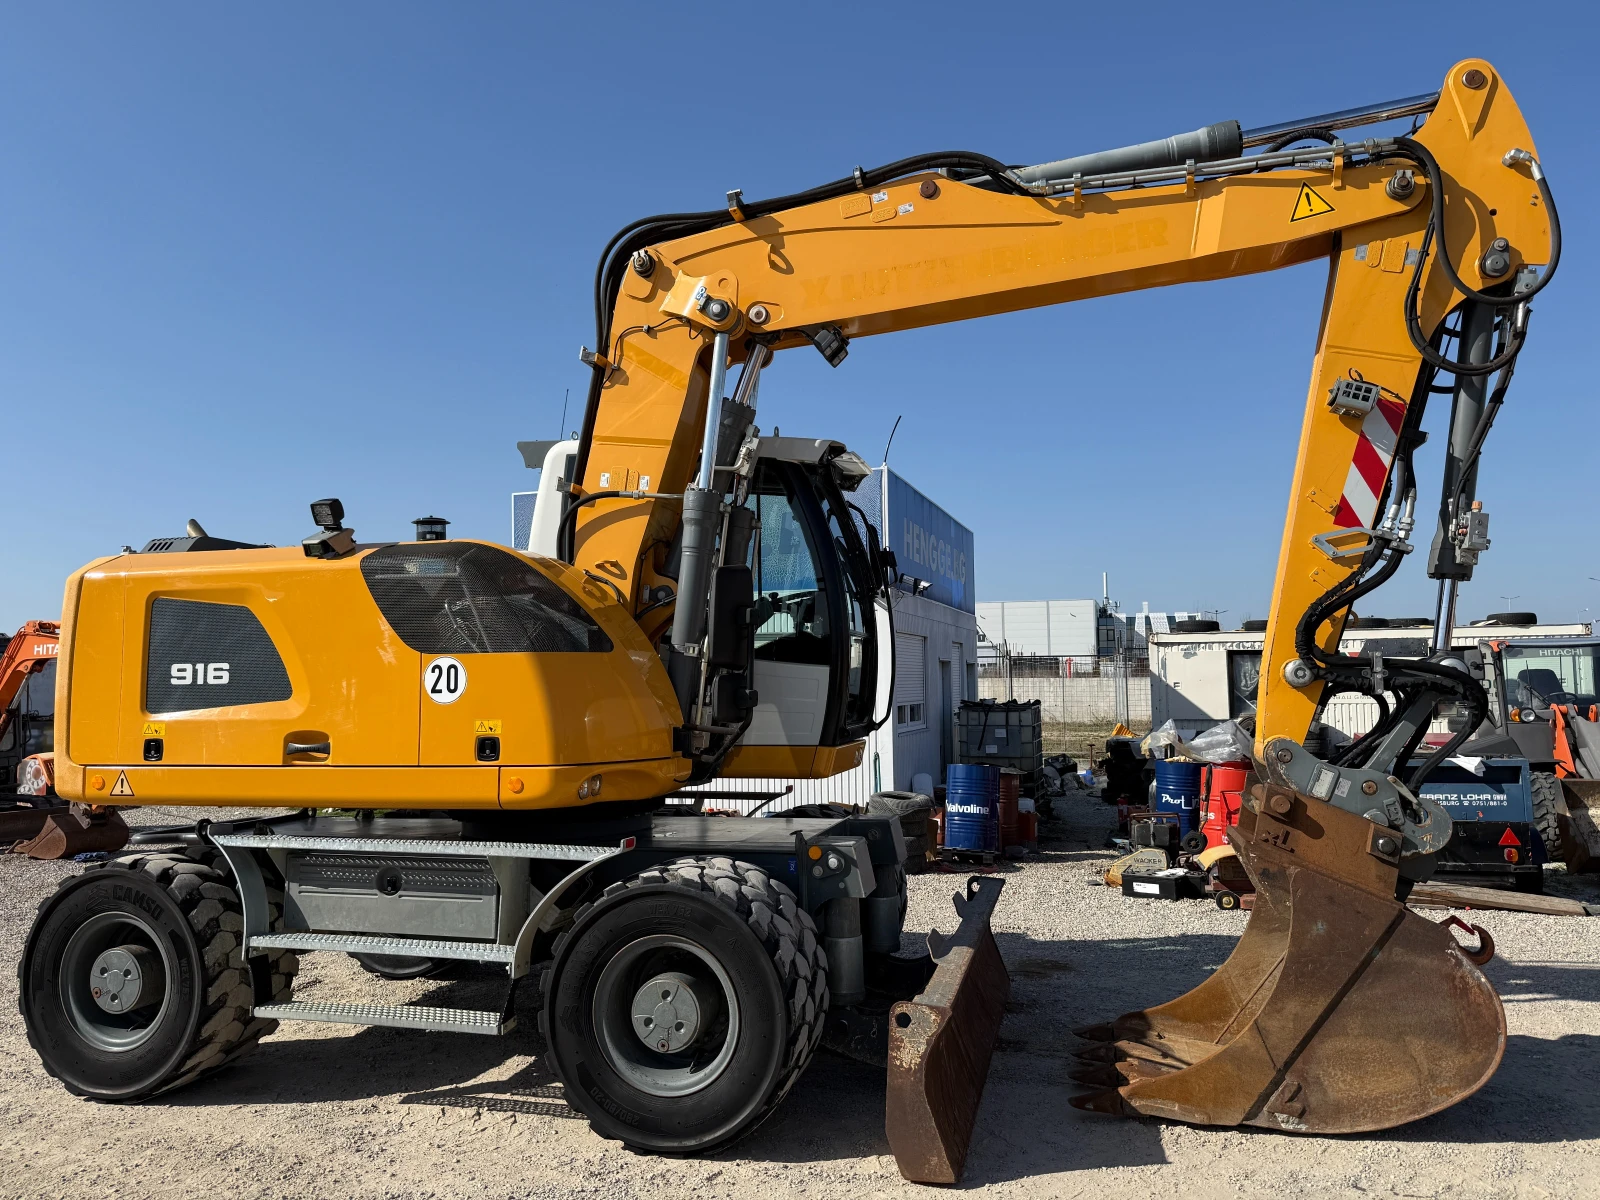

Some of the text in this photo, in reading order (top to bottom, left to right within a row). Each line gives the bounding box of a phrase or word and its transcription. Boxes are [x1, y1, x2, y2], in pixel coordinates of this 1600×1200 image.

[1539, 648, 1583, 656] HITACHI
[170, 662, 230, 685] 916
[430, 663, 459, 694] 20
[1420, 793, 1458, 801] FRANZ
[1460, 793, 1491, 801] LOHR
[946, 800, 990, 815] Valvoline
[1133, 857, 1163, 865] WACKER
[112, 884, 165, 921] CAMSO
